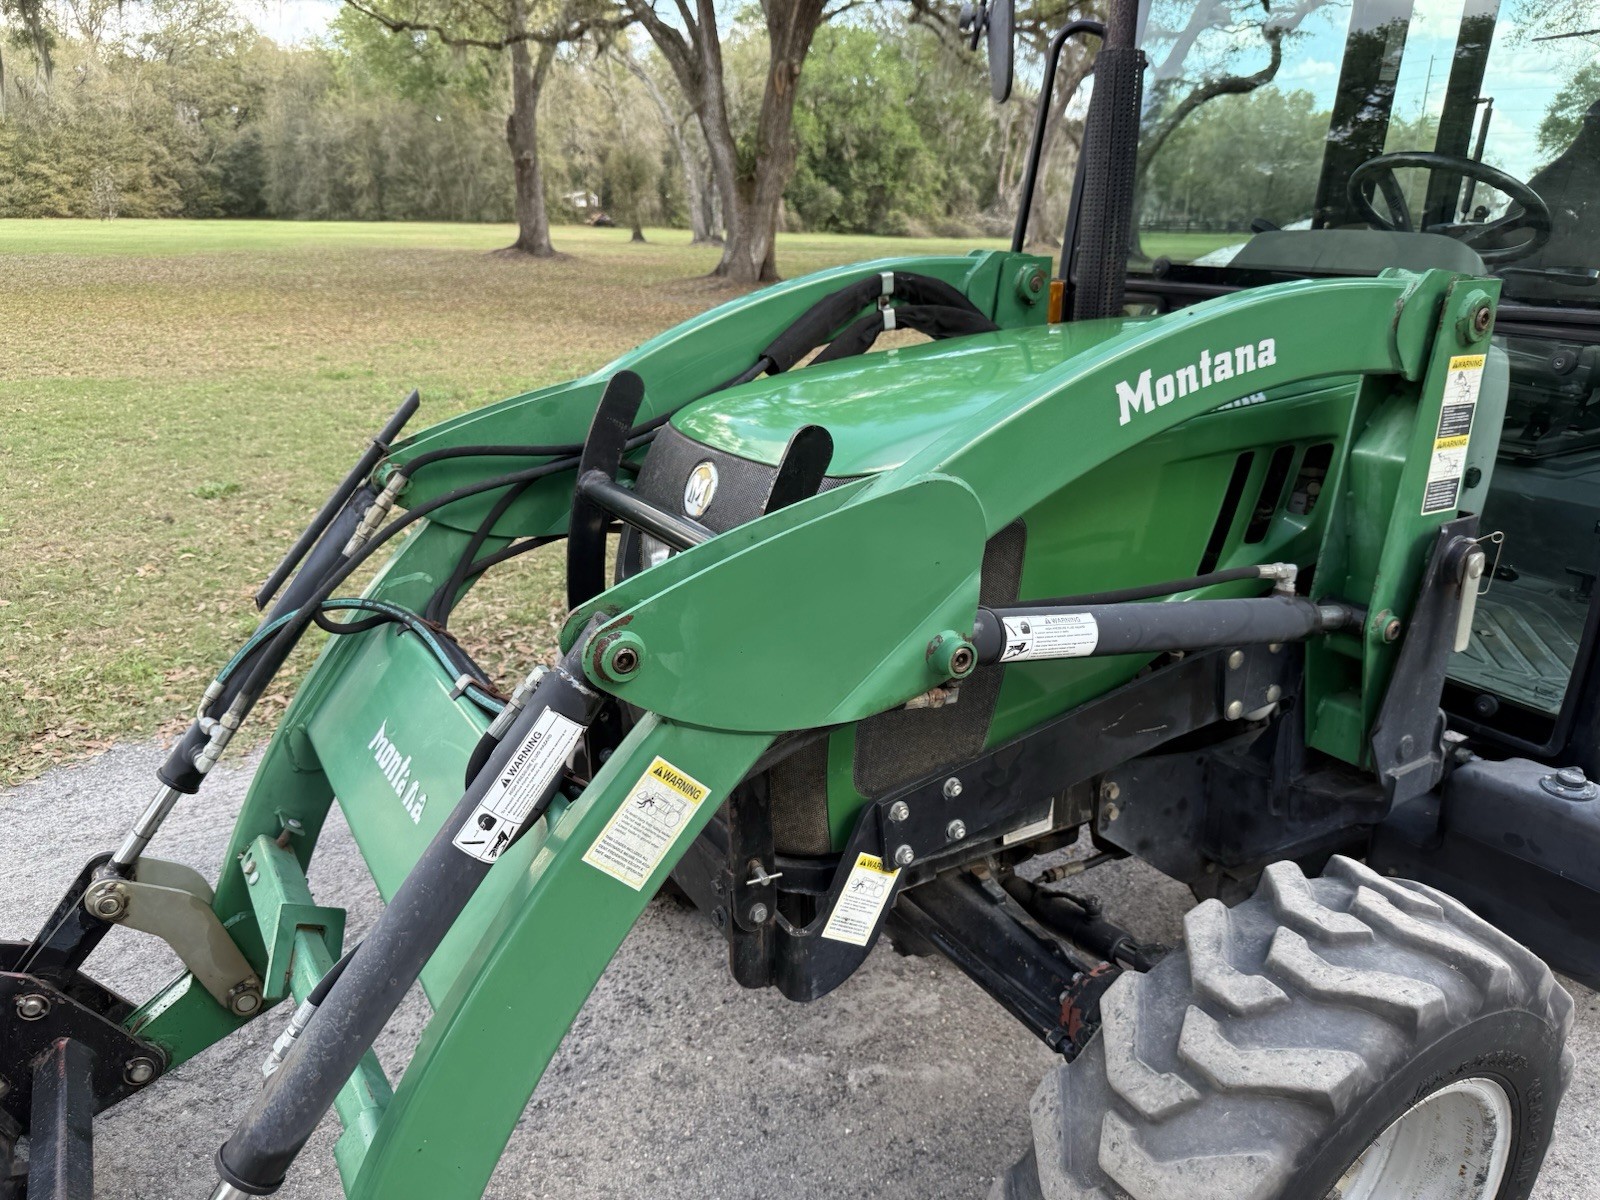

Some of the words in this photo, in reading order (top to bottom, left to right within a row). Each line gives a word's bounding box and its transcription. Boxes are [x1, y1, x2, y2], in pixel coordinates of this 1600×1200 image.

[1457, 359, 1483, 369] WARNING
[1115, 338, 1277, 426] Montana
[1441, 438, 1467, 449] WARNING
[1052, 616, 1081, 624] WARNING
[506, 730, 542, 776] WARNING
[367, 716, 427, 825] Montana
[662, 769, 701, 800] WARNING
